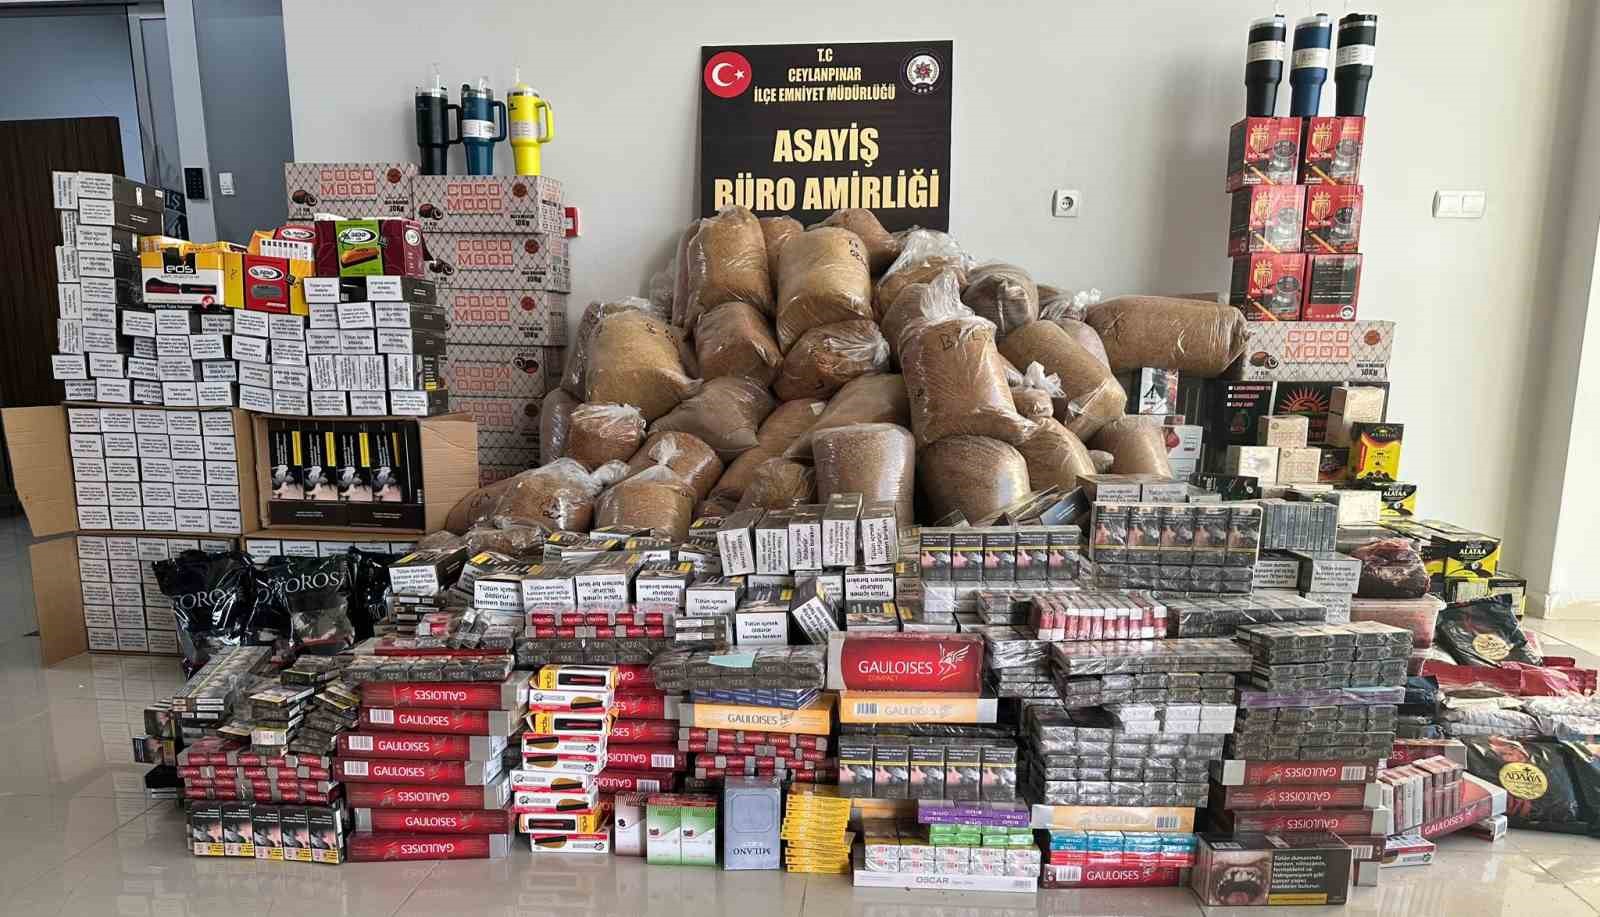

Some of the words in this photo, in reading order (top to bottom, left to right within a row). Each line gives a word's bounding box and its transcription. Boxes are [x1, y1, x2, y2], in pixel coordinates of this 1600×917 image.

[817, 48, 833, 62] T.C
[788, 67, 862, 82] CEYLANPINAR
[754, 88, 777, 104] İLÇE
[778, 86, 825, 102] EMNİYET
[827, 84, 896, 101] MÜDÜRLÜĞÜ
[773, 123, 879, 167] ASAYİŞ
[320, 169, 374, 181] COCO
[447, 183, 500, 195] COCO
[714, 172, 796, 211] BÜRO
[803, 168, 939, 211] AMİRLİĞİ
[458, 239, 512, 251] COCO
[455, 295, 508, 307] COCO
[1288, 330, 1349, 342] COCO
[1286, 345, 1349, 358] MOOD
[475, 415, 513, 426] OOD
[858, 660, 933, 675] GAULOISES
[414, 690, 467, 700] GAULOISES
[399, 714, 449, 726] GAULOISES
[727, 713, 778, 725] GAULOISES
[378, 740, 430, 752] GAULOISES
[373, 766, 425, 777] GAULOISES
[1284, 767, 1337, 777] GAULOISES
[398, 791, 450, 801] GAULOISES
[1279, 791, 1331, 801] GAULOISES
[405, 816, 457, 827] GAULOISES
[1287, 819, 1339, 830] GAULOISES
[401, 843, 455, 854] GAULOISES
[916, 876, 949, 884] OSCAR
[1086, 870, 1139, 881] GAULOISES
